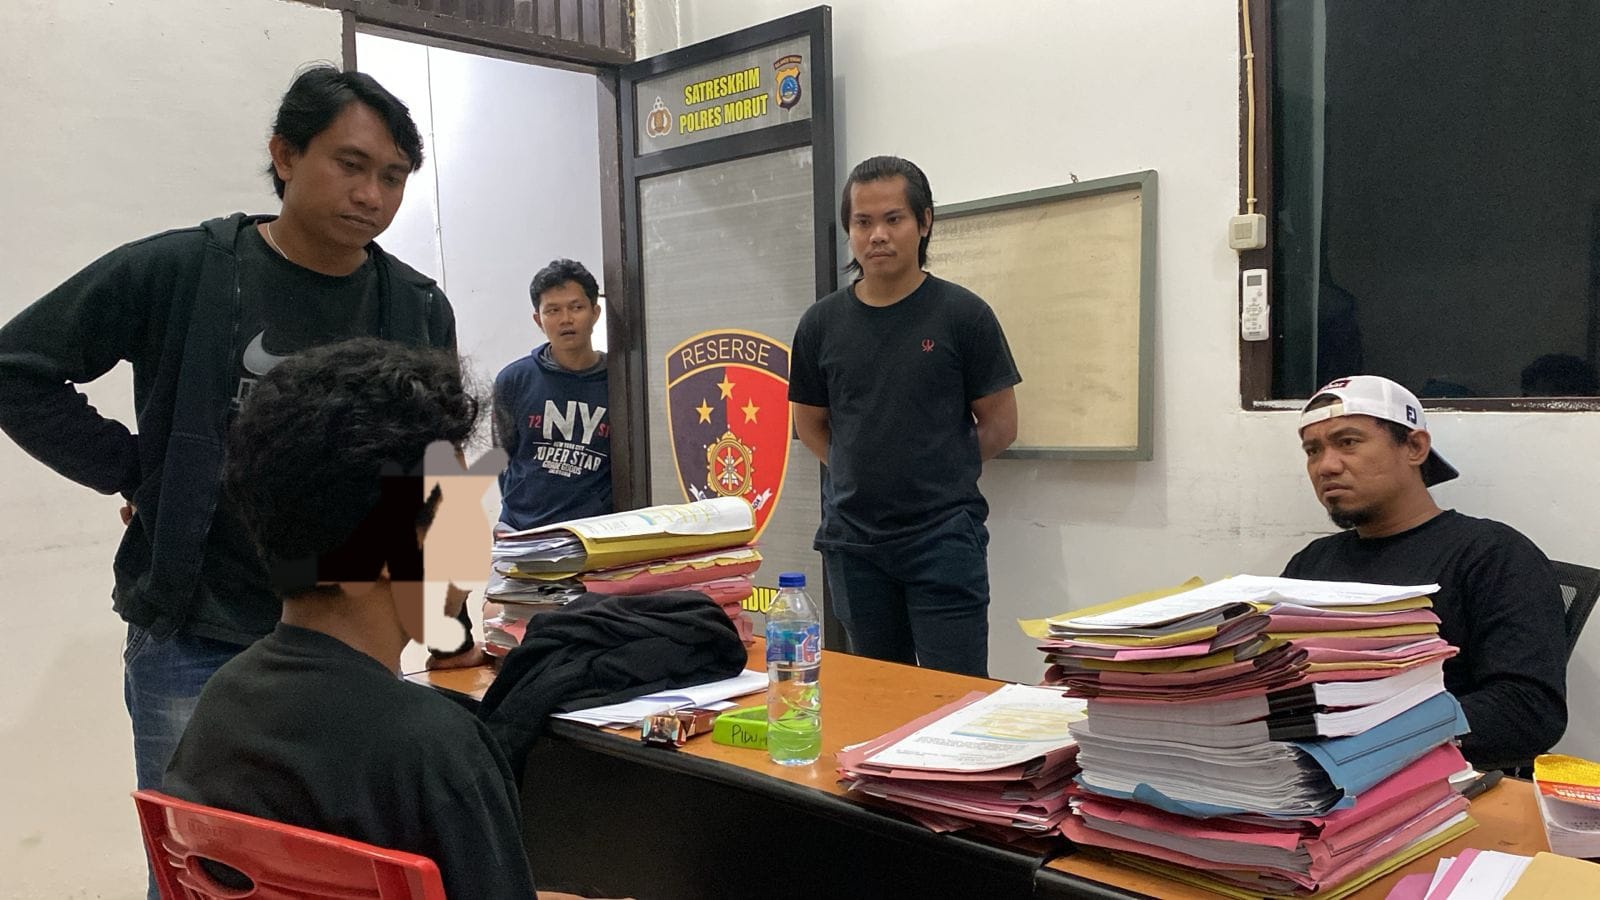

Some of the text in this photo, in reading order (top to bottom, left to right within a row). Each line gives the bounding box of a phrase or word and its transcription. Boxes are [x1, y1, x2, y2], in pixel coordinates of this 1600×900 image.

[684, 67, 760, 105] SATRESKRIM
[679, 94, 768, 135] POLRES MORUT
[681, 338, 771, 369] RESERSE
[542, 400, 607, 445] NY
[533, 446, 570, 463] UPER
[570, 451, 602, 472] STAR
